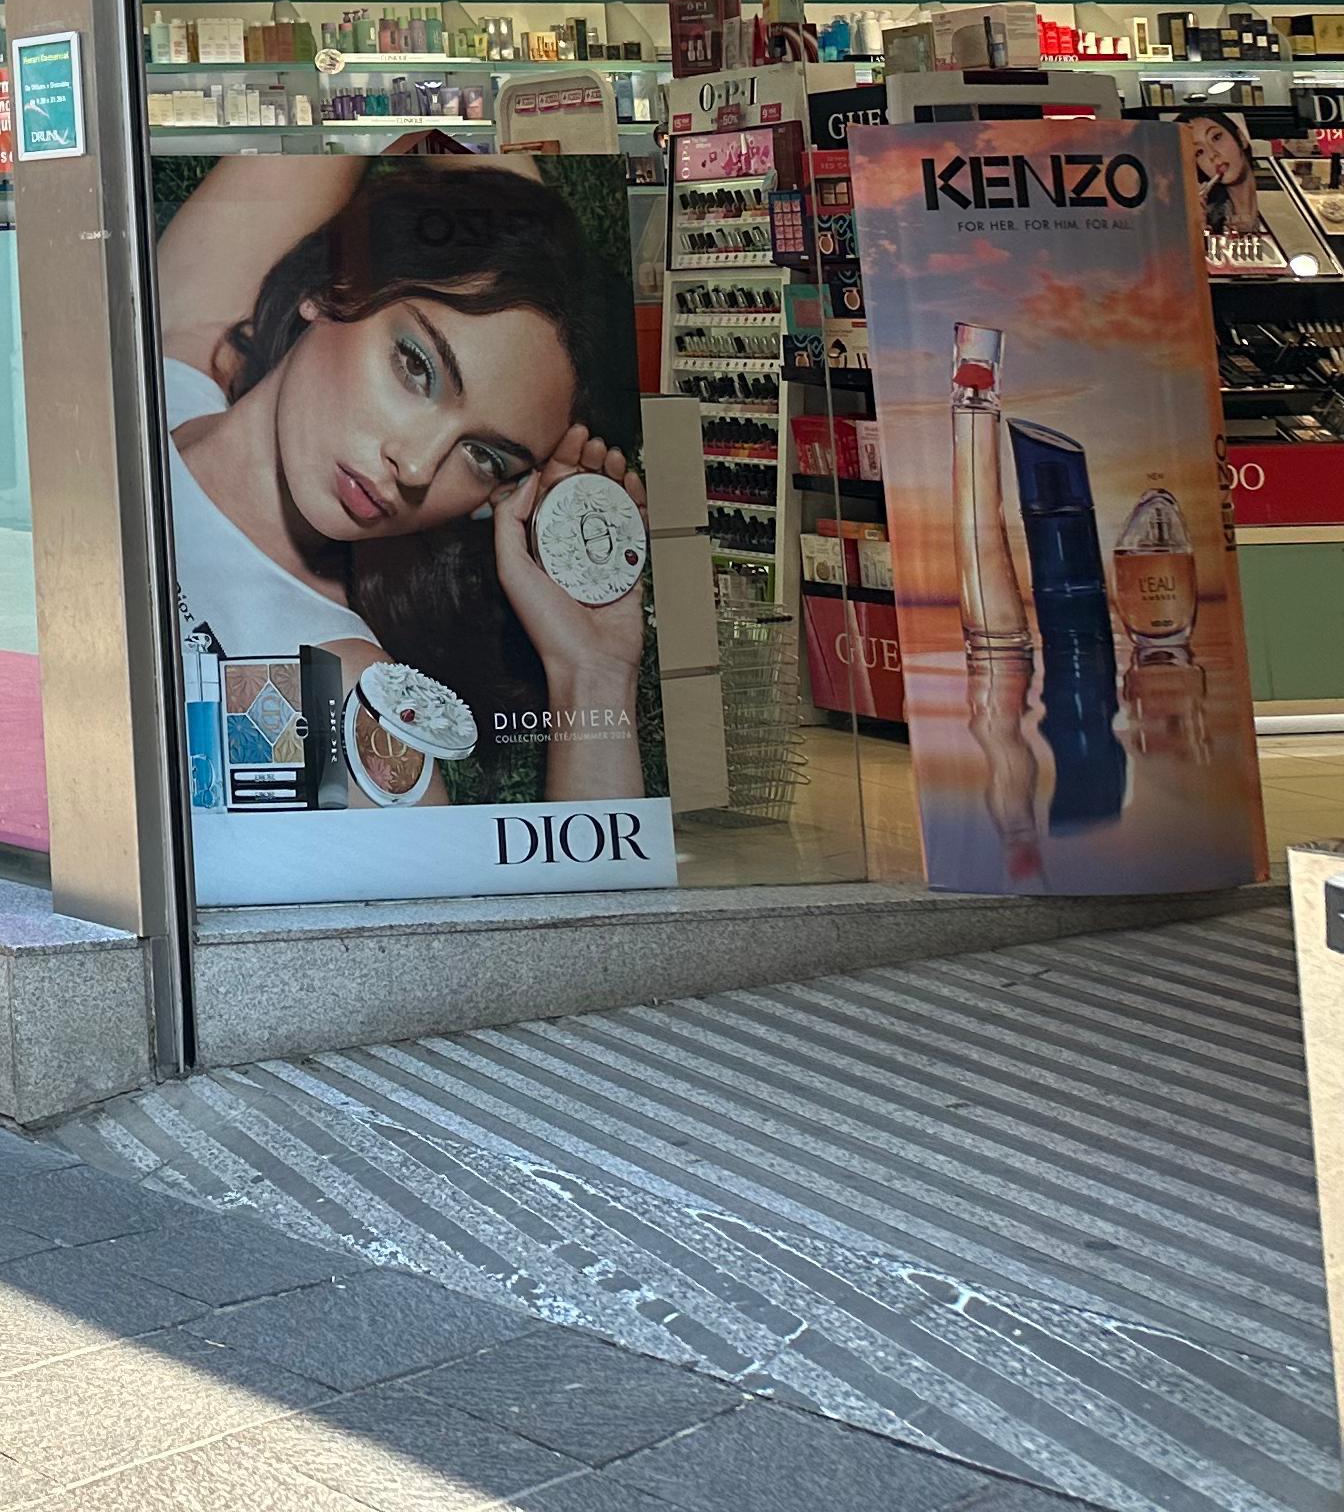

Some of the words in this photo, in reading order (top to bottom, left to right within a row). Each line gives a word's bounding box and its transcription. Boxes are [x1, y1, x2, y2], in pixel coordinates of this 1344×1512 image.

[921, 153, 1149, 210] KENZO
[958, 221, 985, 232] FOR
[1025, 220, 1050, 230] FOR
[1085, 219, 1108, 229] FOR
[834, 631, 902, 673] GUE
[494, 709, 632, 730] DIORIVIERA
[495, 733, 551, 744] COLLECTION
[493, 812, 650, 867] DIOR
